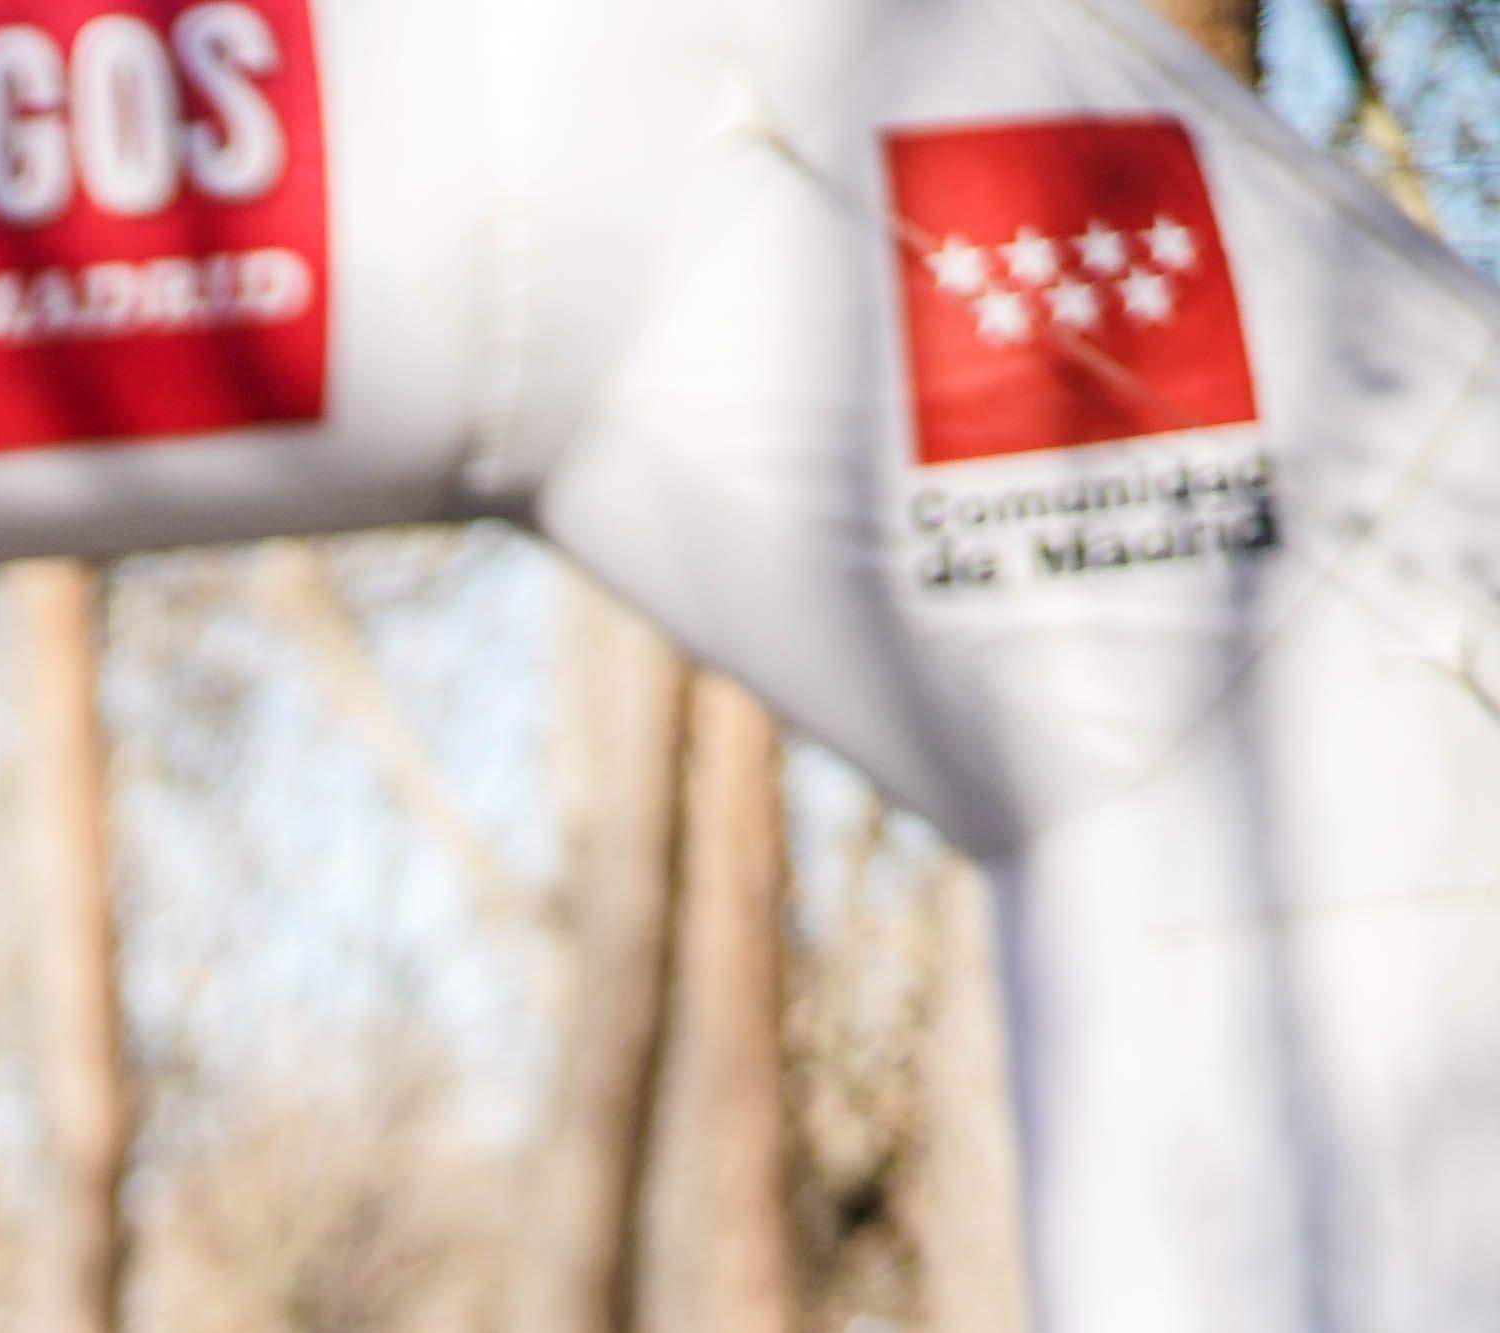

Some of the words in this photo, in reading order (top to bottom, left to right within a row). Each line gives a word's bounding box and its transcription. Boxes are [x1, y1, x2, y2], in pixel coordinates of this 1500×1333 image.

[911, 457, 1273, 532] Comunidad
[918, 538, 999, 589] de
[1031, 497, 1283, 577] Madrid
